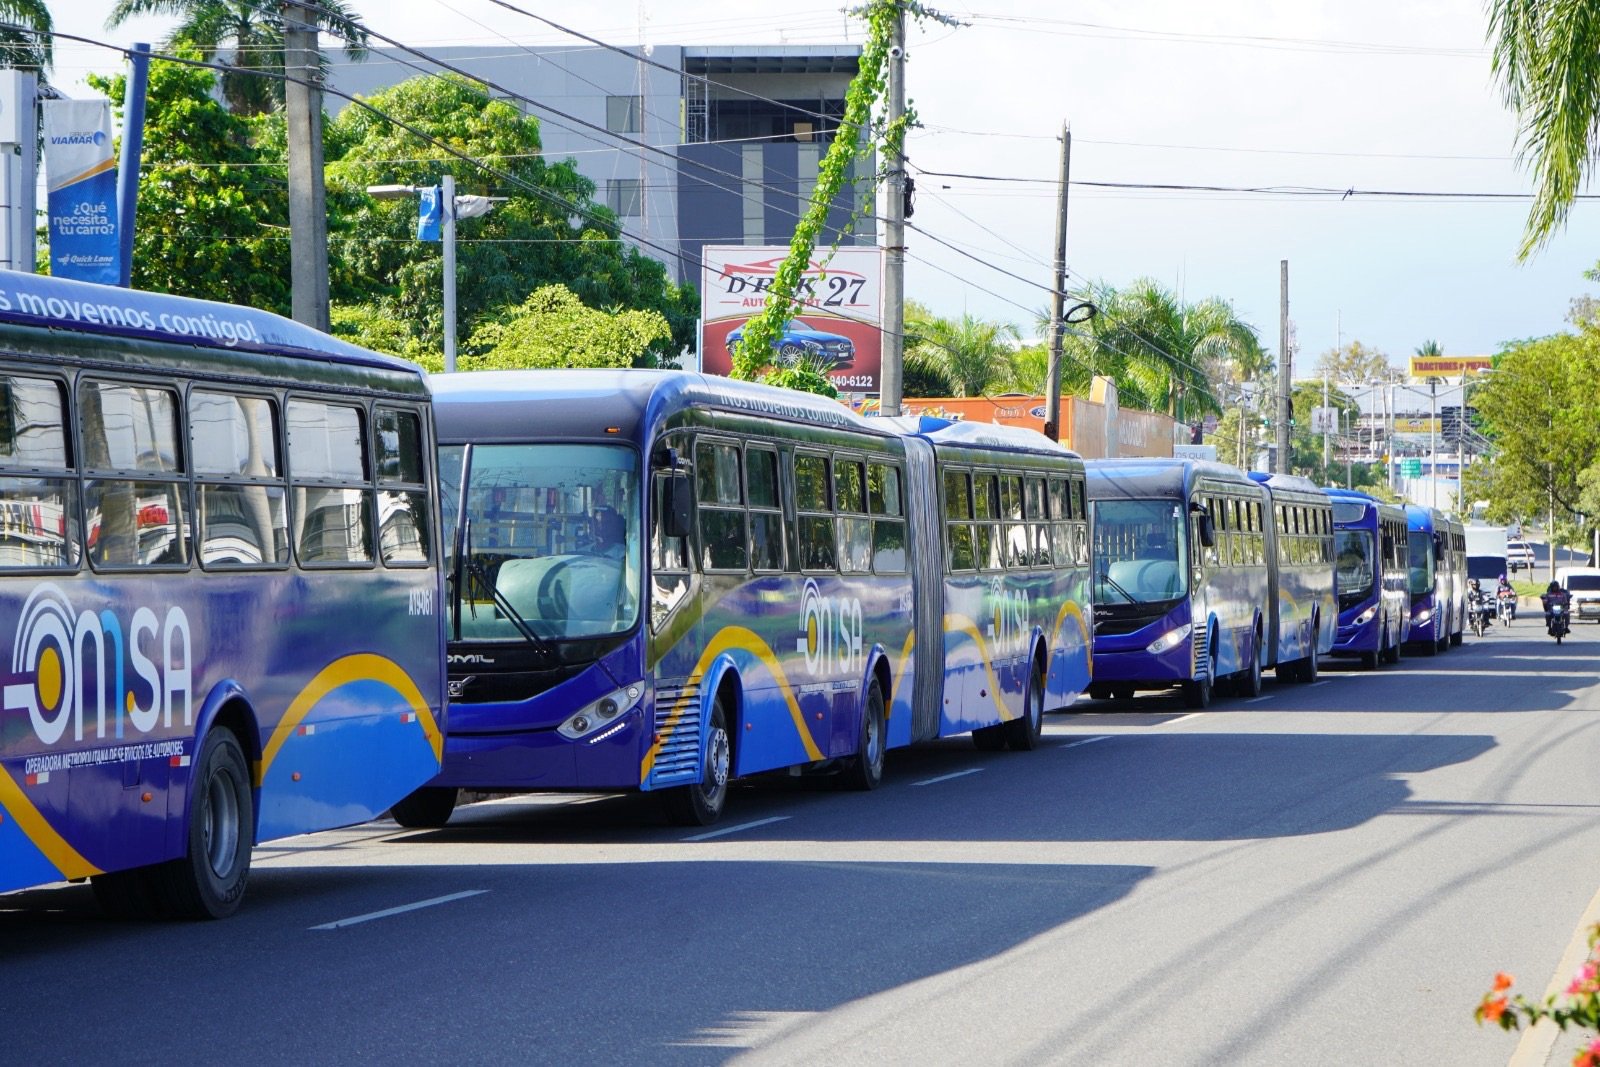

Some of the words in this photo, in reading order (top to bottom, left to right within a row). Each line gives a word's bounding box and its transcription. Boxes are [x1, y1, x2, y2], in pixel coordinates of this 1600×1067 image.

[51, 136, 93, 145] VIAMAR
[73, 202, 107, 215] ¿Qué
[53, 213, 108, 225] necesita
[59, 226, 74, 235] tu
[75, 224, 115, 235] carro?
[70, 255, 92, 263] Quick
[823, 276, 866, 306] 27
[16, 292, 156, 330] movemos
[159, 312, 262, 347] contigo!
[749, 398, 805, 418] movemos
[25, 755, 62, 775] OPERADORA
